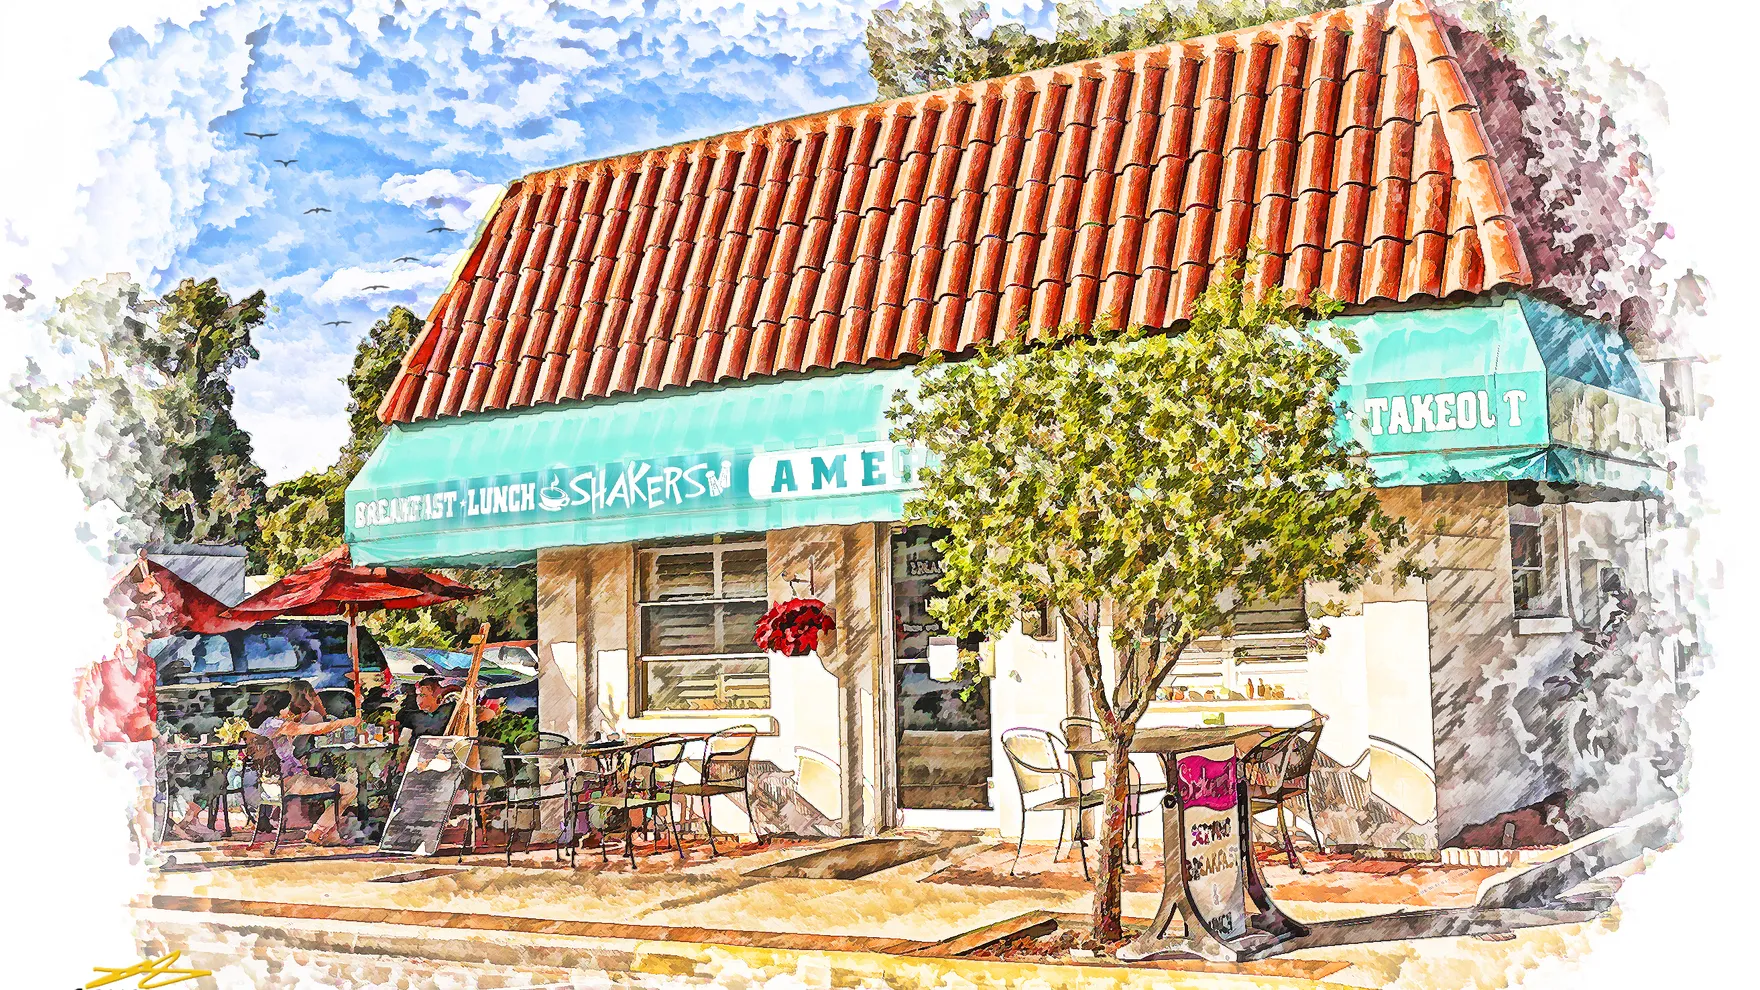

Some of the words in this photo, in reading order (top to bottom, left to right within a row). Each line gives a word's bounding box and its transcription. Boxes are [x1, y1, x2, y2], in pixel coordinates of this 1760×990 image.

[354, 491, 457, 529] BREAKFAST
[467, 483, 536, 516] LUNCH
[569, 460, 708, 515] SHAKERS
